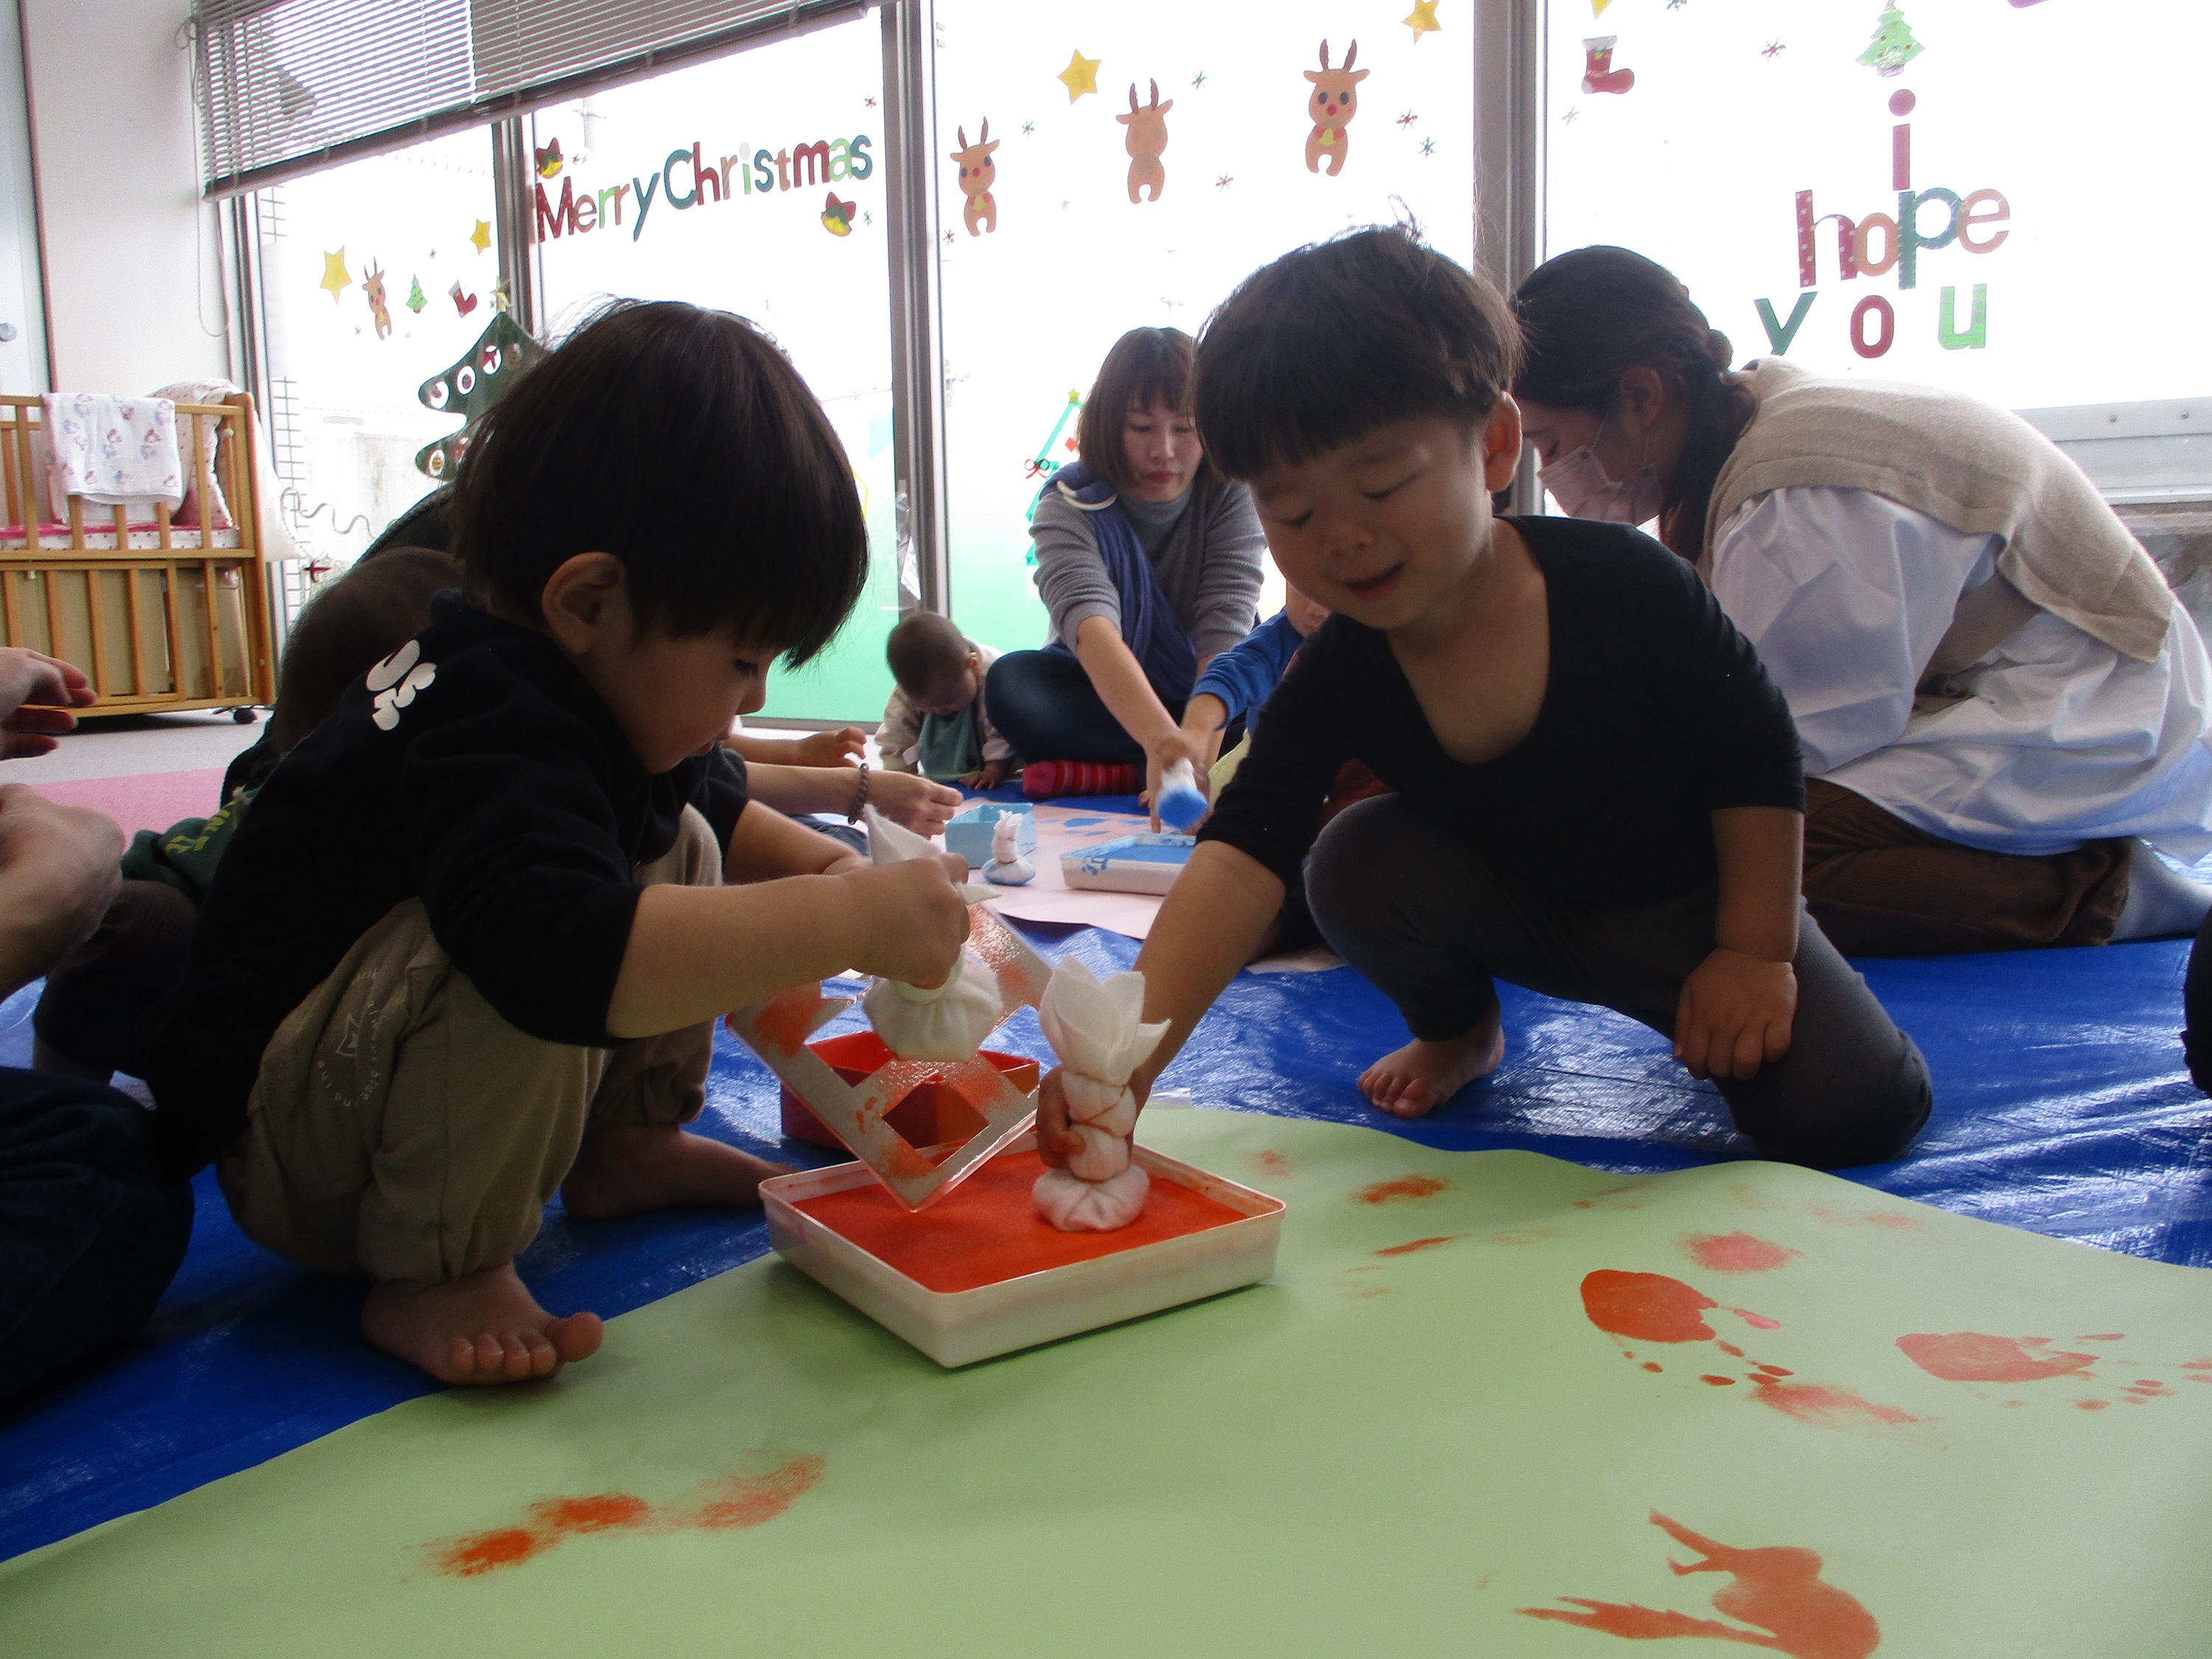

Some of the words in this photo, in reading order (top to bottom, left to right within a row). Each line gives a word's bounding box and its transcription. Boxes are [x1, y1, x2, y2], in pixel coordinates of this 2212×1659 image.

[538, 172, 661, 242] Merry
[663, 134, 873, 210] Christmas
[1795, 187, 2010, 291] hope
